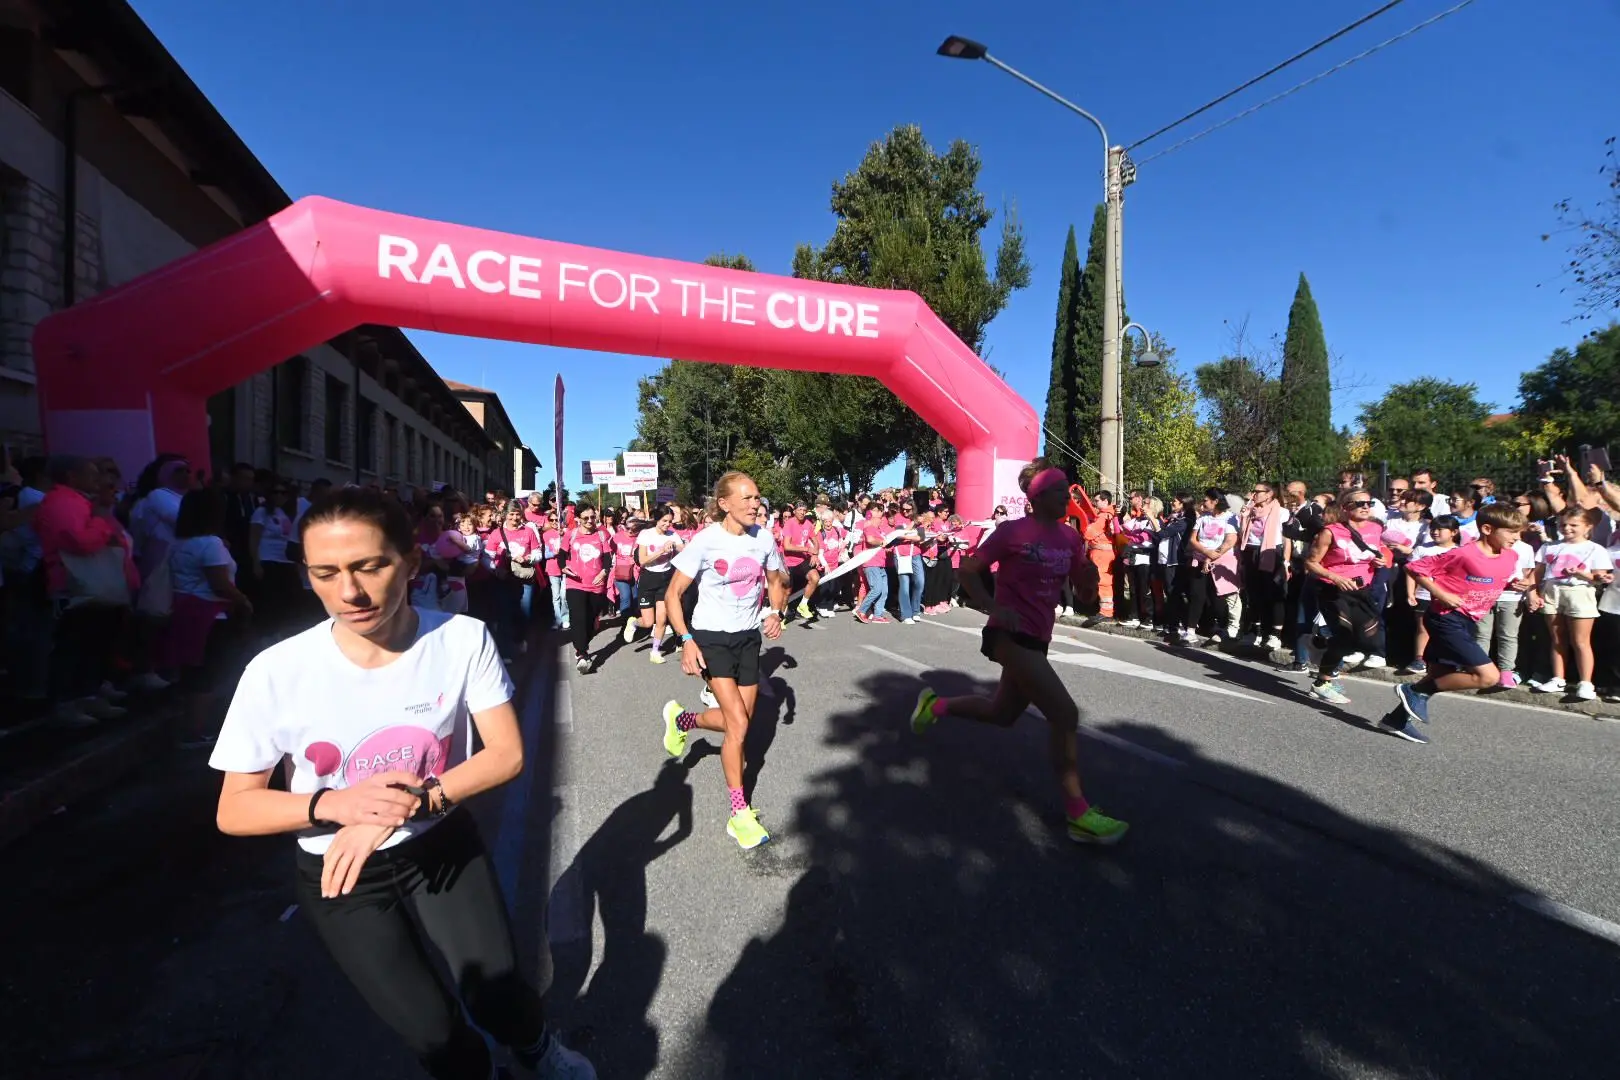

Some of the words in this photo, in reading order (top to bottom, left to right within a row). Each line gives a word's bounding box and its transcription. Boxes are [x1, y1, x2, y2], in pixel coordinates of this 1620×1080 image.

[377, 234, 542, 299] RACE
[558, 262, 660, 315] FOR
[671, 278, 756, 326] THE
[766, 292, 880, 339] CURE
[355, 745, 415, 771] RACE
